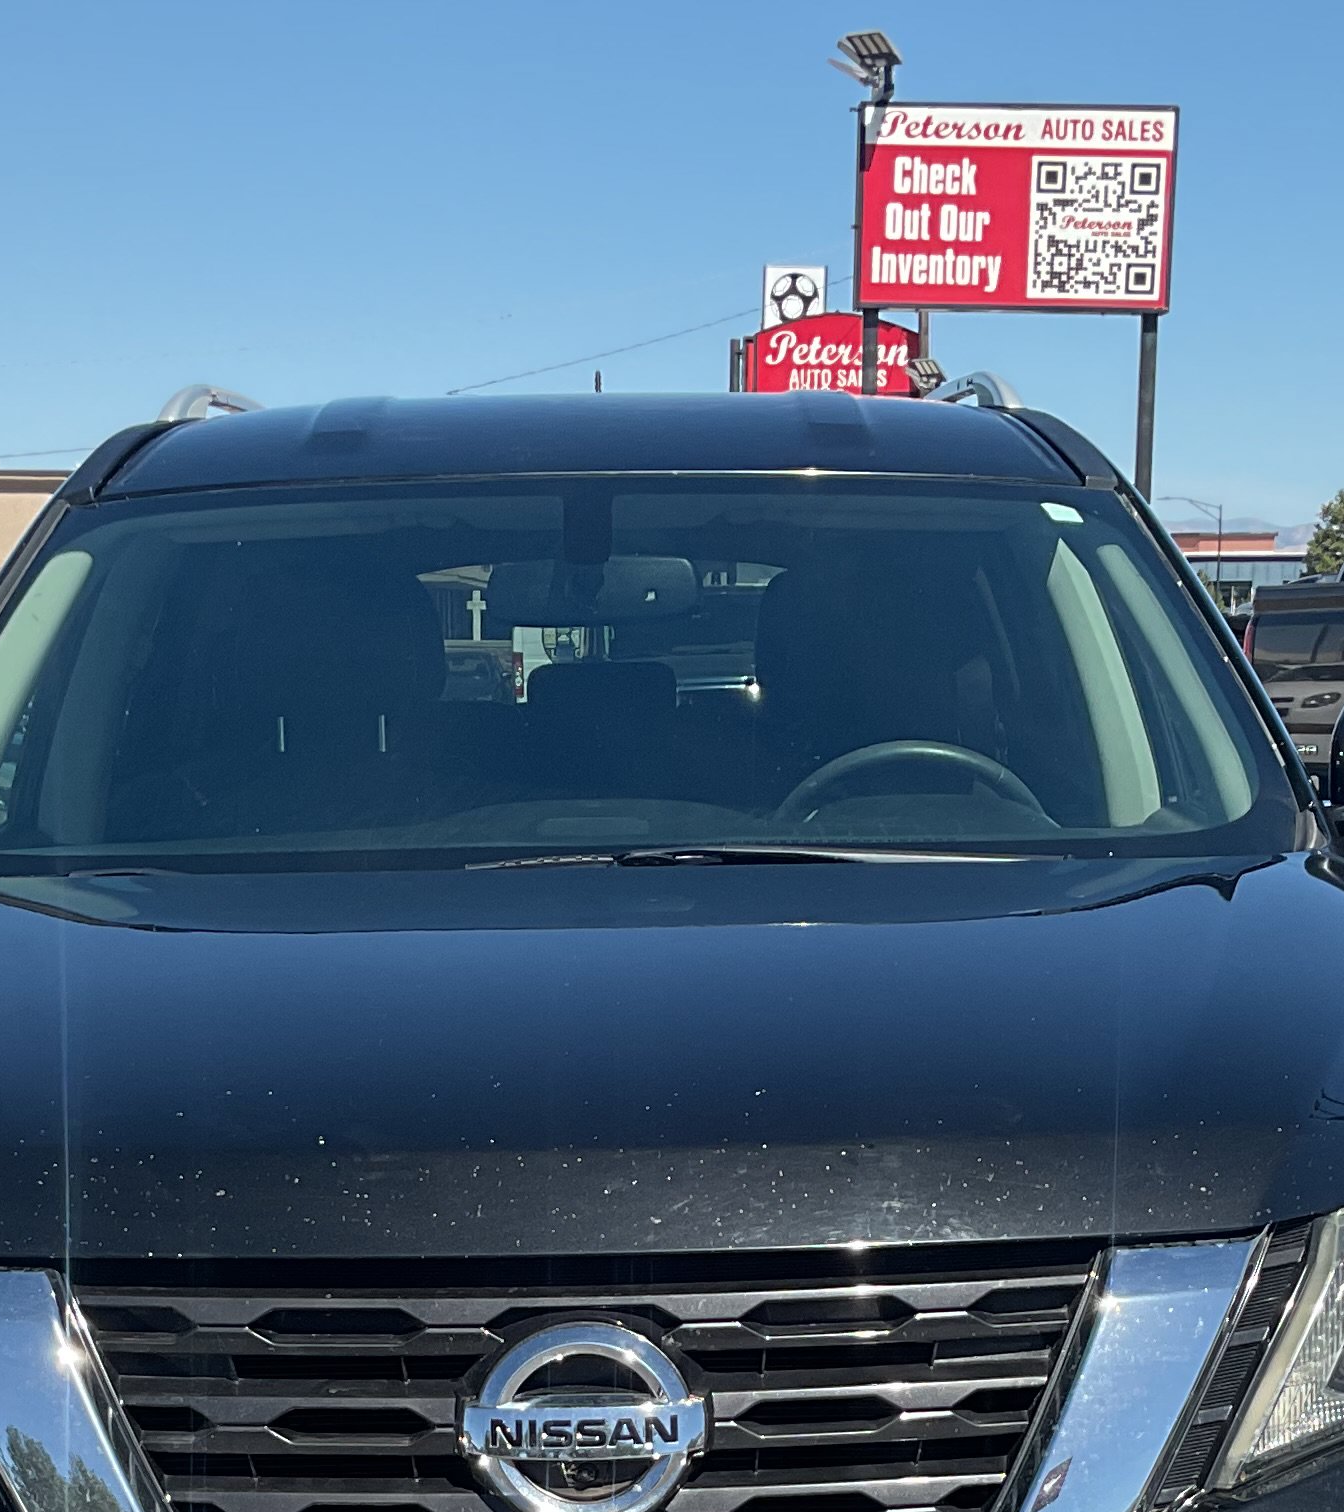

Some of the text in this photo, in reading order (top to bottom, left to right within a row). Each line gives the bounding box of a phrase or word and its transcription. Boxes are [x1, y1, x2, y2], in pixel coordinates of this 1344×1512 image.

[876, 110, 1165, 142] Peterson AUTO SALES
[893, 155, 977, 196] Check
[884, 202, 990, 242] Out Our
[1059, 215, 1134, 230] Peterson
[870, 246, 1002, 293] Inventory
[837, 368, 887, 387] SAS
[489, 1414, 678, 1449] NISSAN
